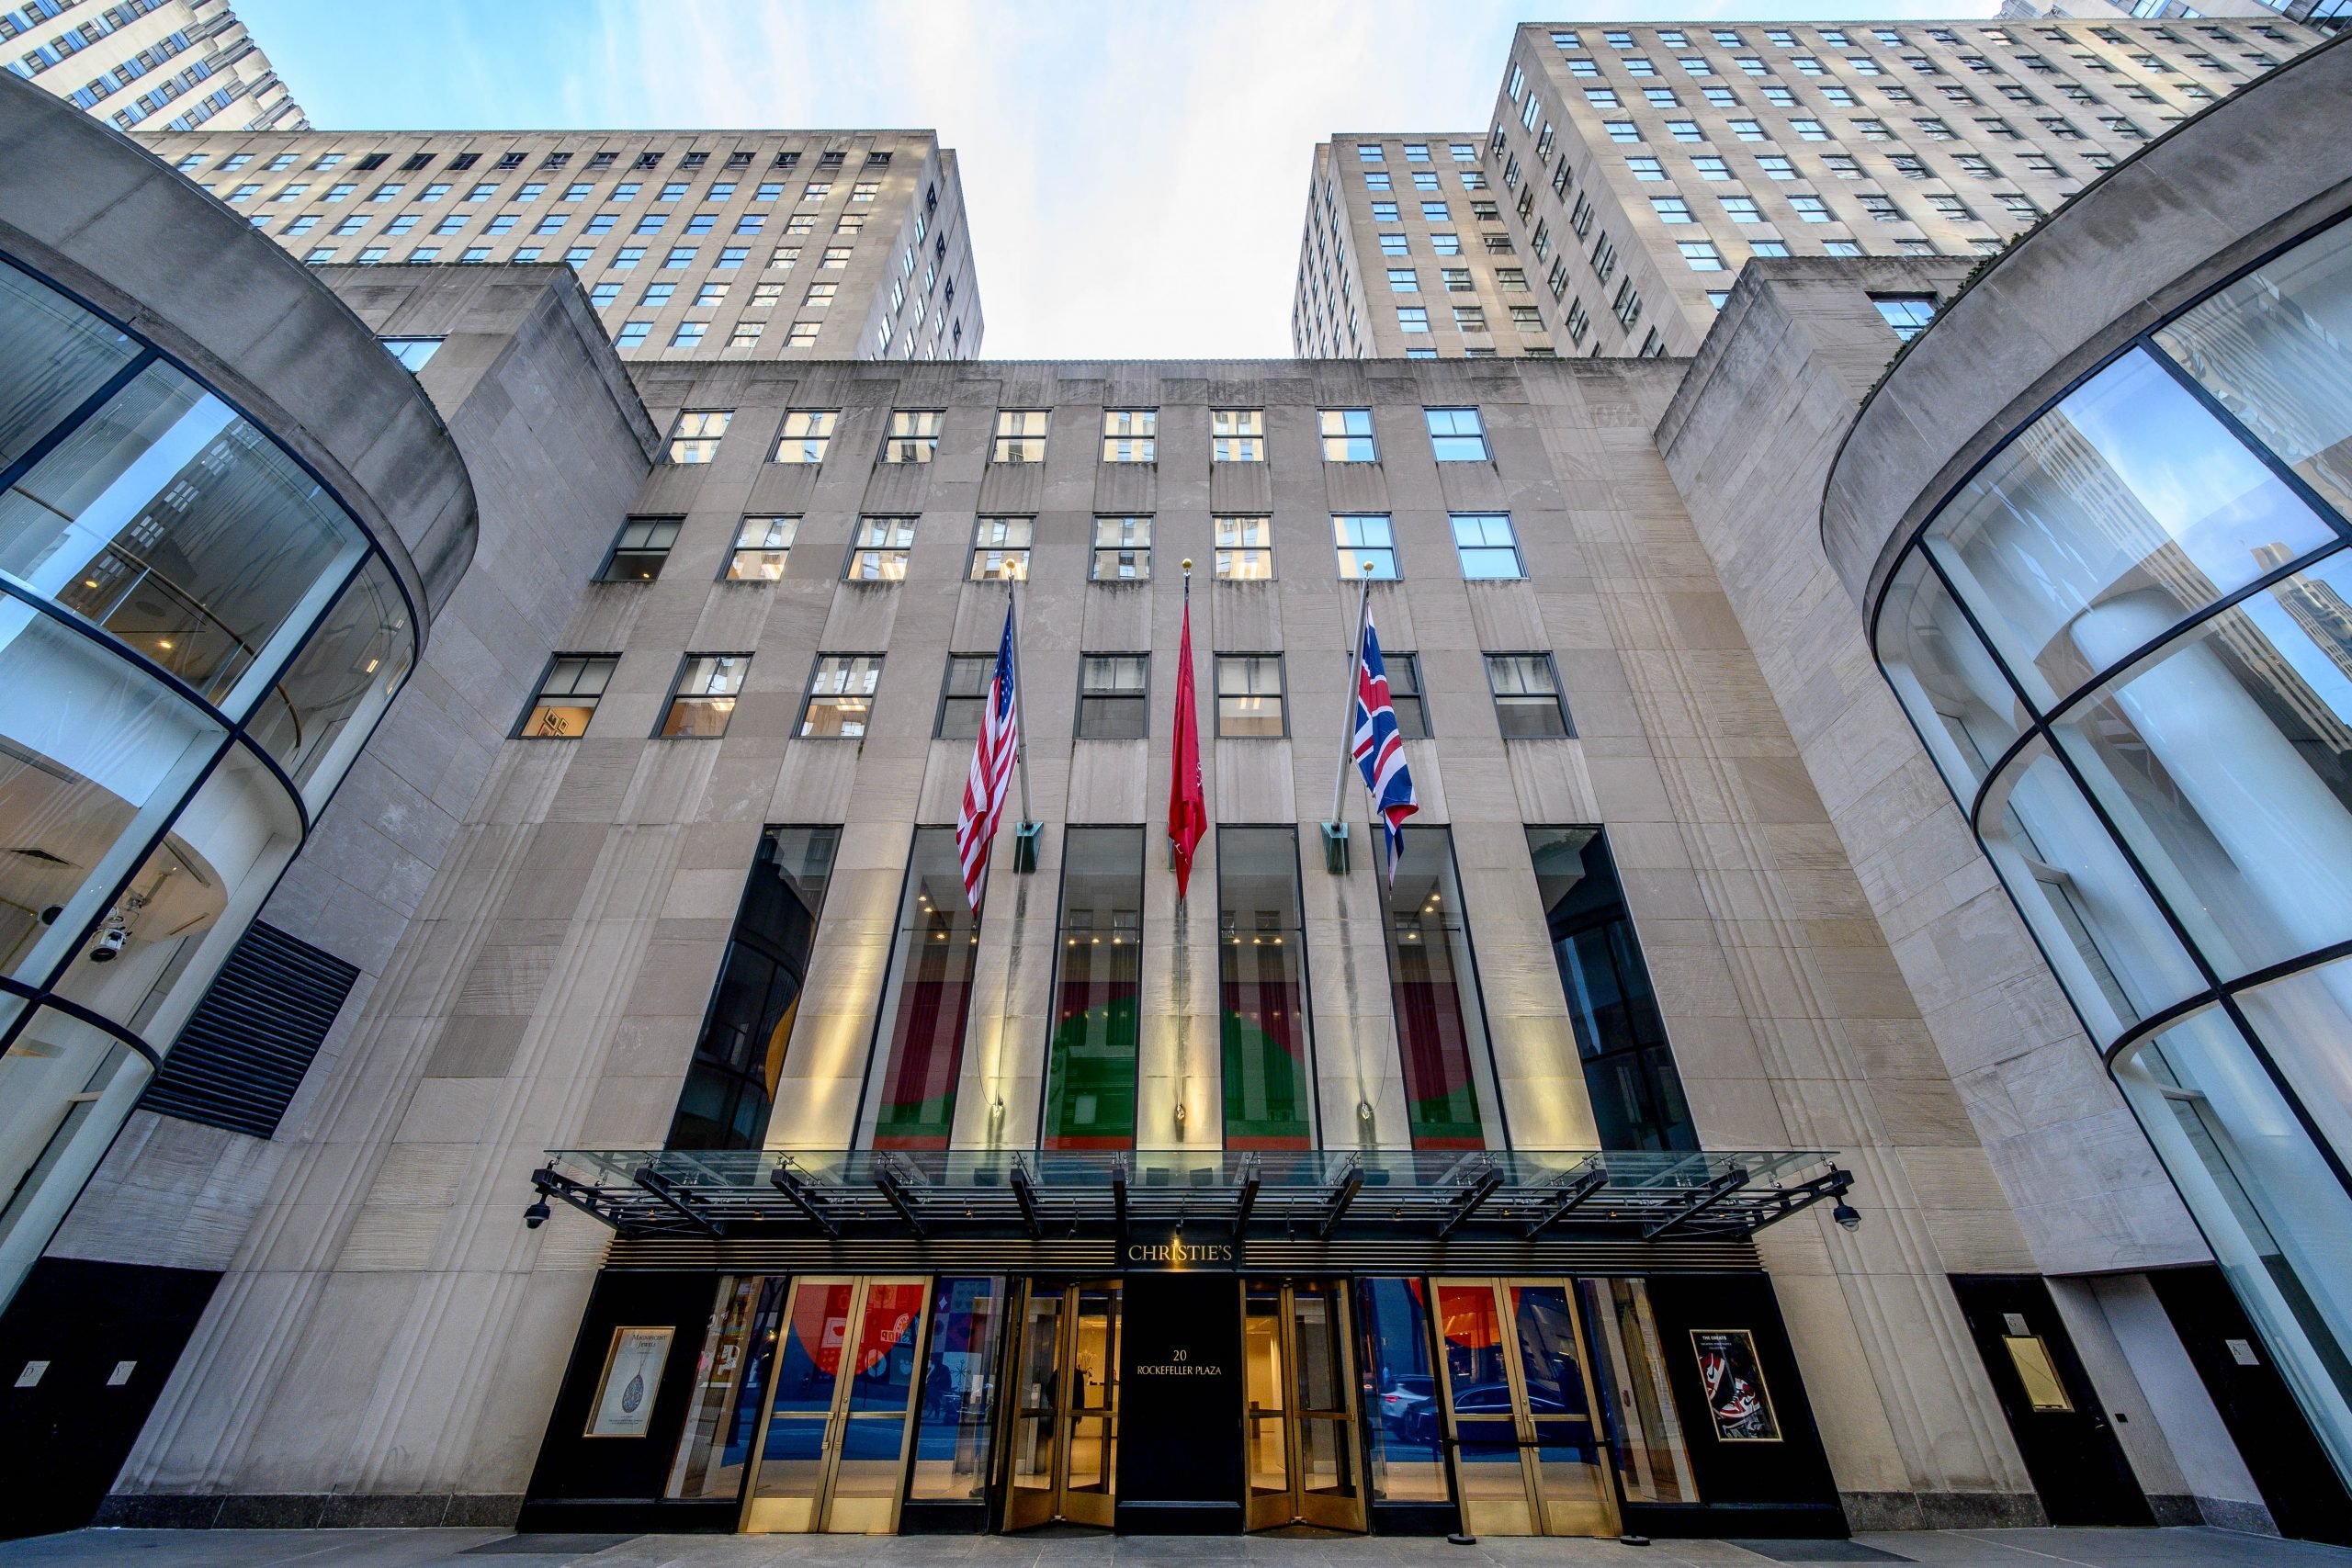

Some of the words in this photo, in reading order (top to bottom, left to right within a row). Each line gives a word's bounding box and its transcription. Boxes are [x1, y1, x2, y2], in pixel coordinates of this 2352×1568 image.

[1128, 1245, 1232, 1261] CHRISTIE'S
[1172, 1349, 1187, 1361] 20
[1136, 1365, 1193, 1375] ROCKEFELLER
[1195, 1365, 1222, 1375] PLAZA
